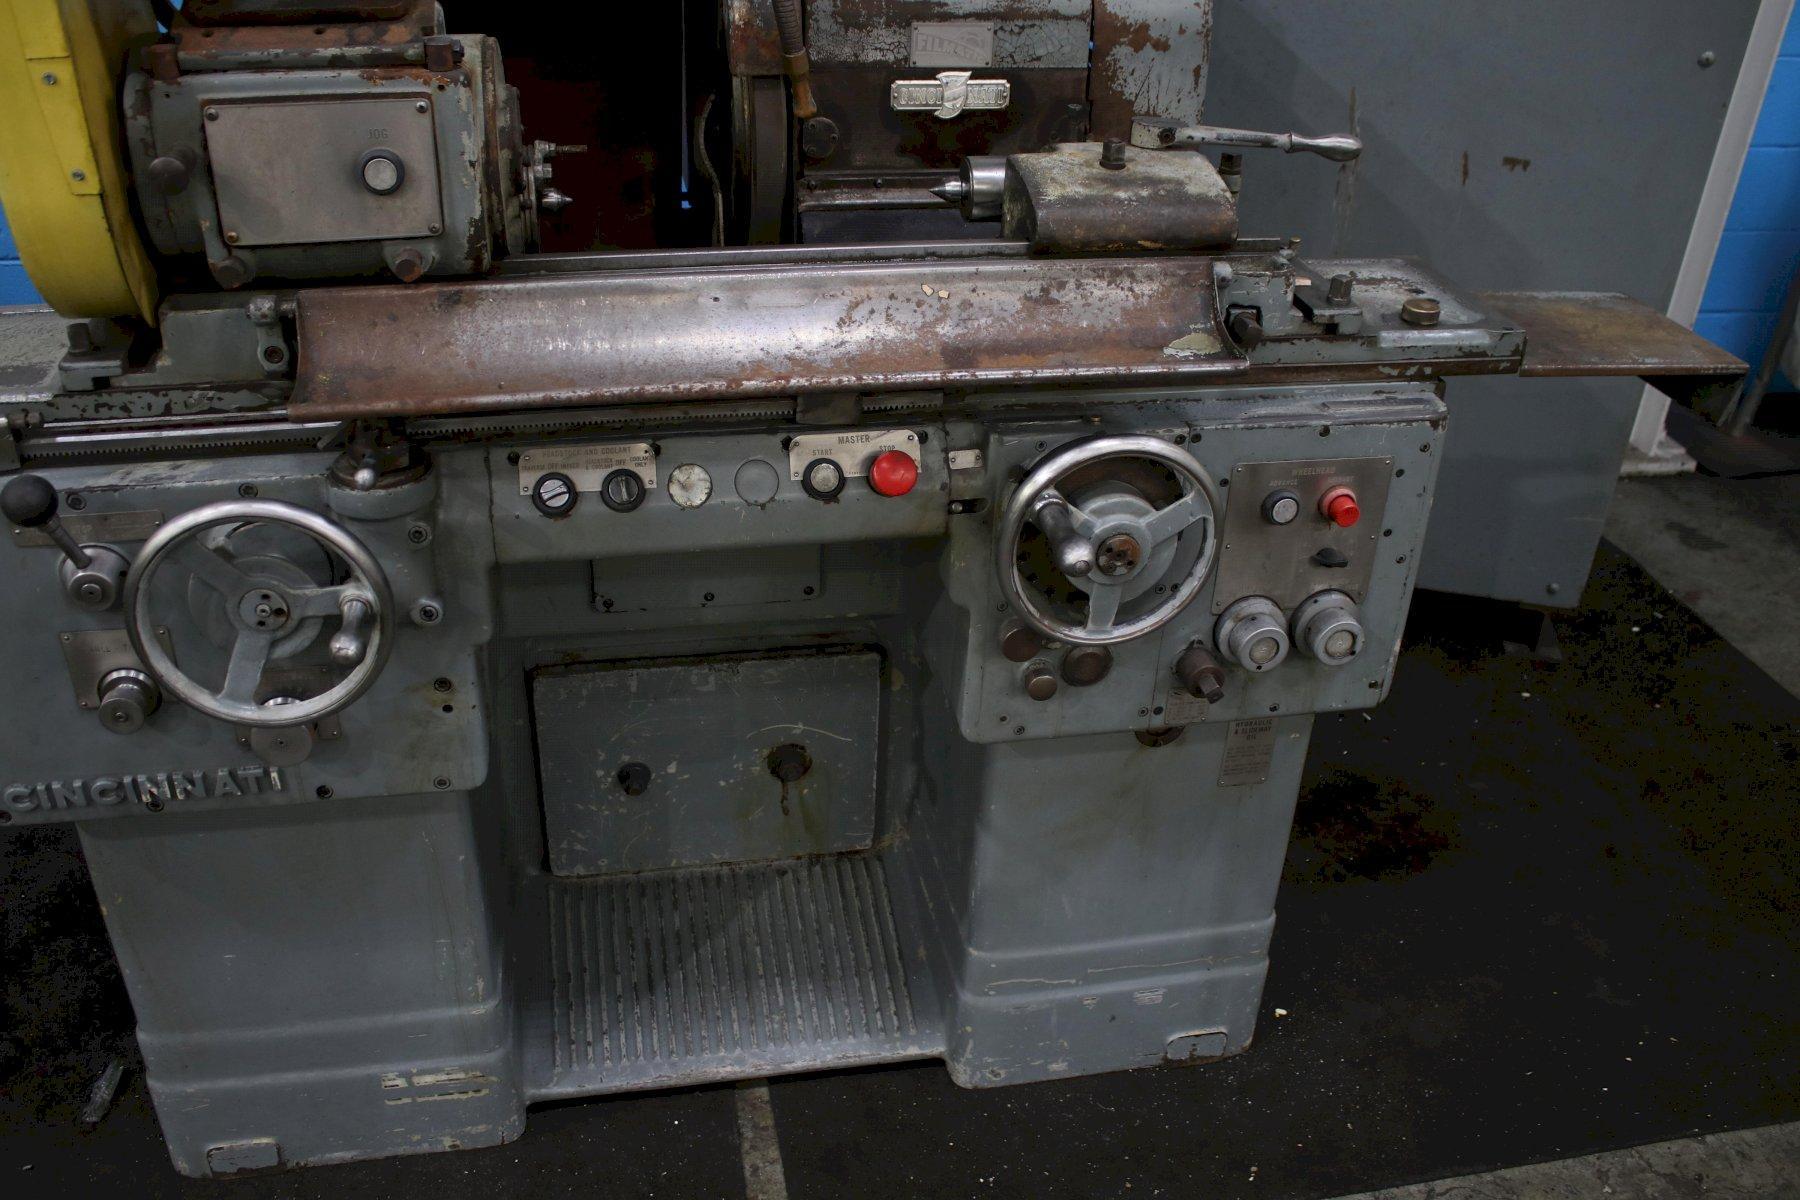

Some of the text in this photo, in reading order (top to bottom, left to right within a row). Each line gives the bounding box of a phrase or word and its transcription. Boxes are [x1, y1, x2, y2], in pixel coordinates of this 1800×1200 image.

[368, 128, 389, 139] JOG
[838, 435, 871, 445] MASTER
[601, 446, 632, 455] COOLANT
[3, 767, 282, 811] CINCINNATI
